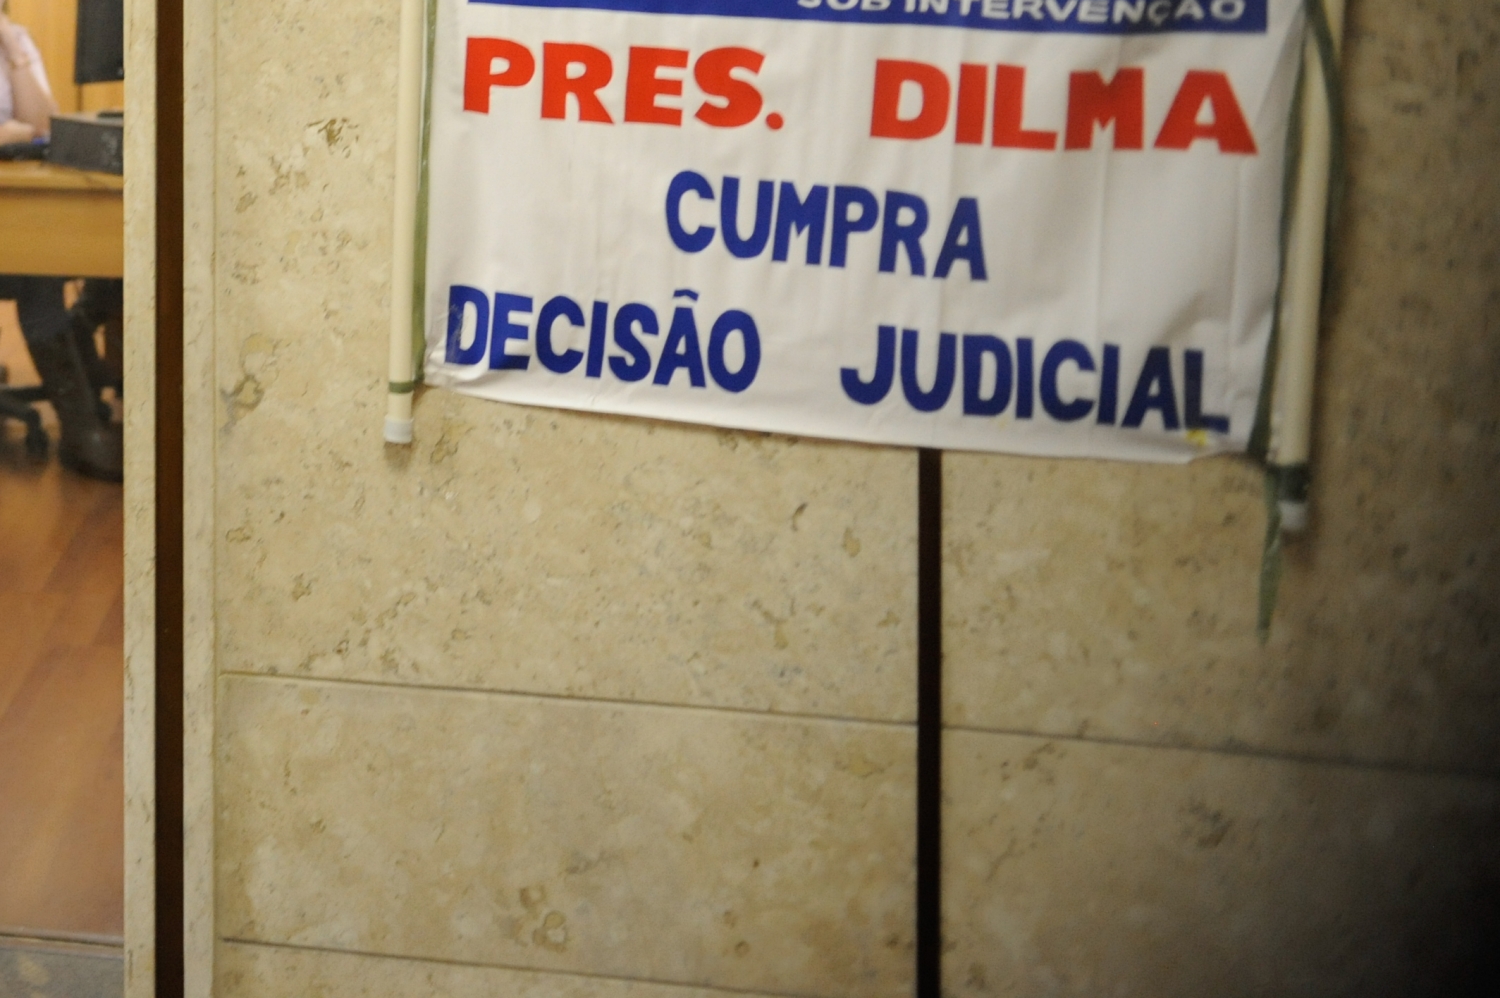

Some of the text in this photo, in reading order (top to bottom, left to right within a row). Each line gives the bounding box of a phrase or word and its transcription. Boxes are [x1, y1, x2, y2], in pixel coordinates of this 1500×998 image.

[462, 36, 1259, 156] PRES. DILMA
[664, 170, 989, 282] CUMPRA
[445, 285, 1230, 435] DECISÃO JUDICIAL
